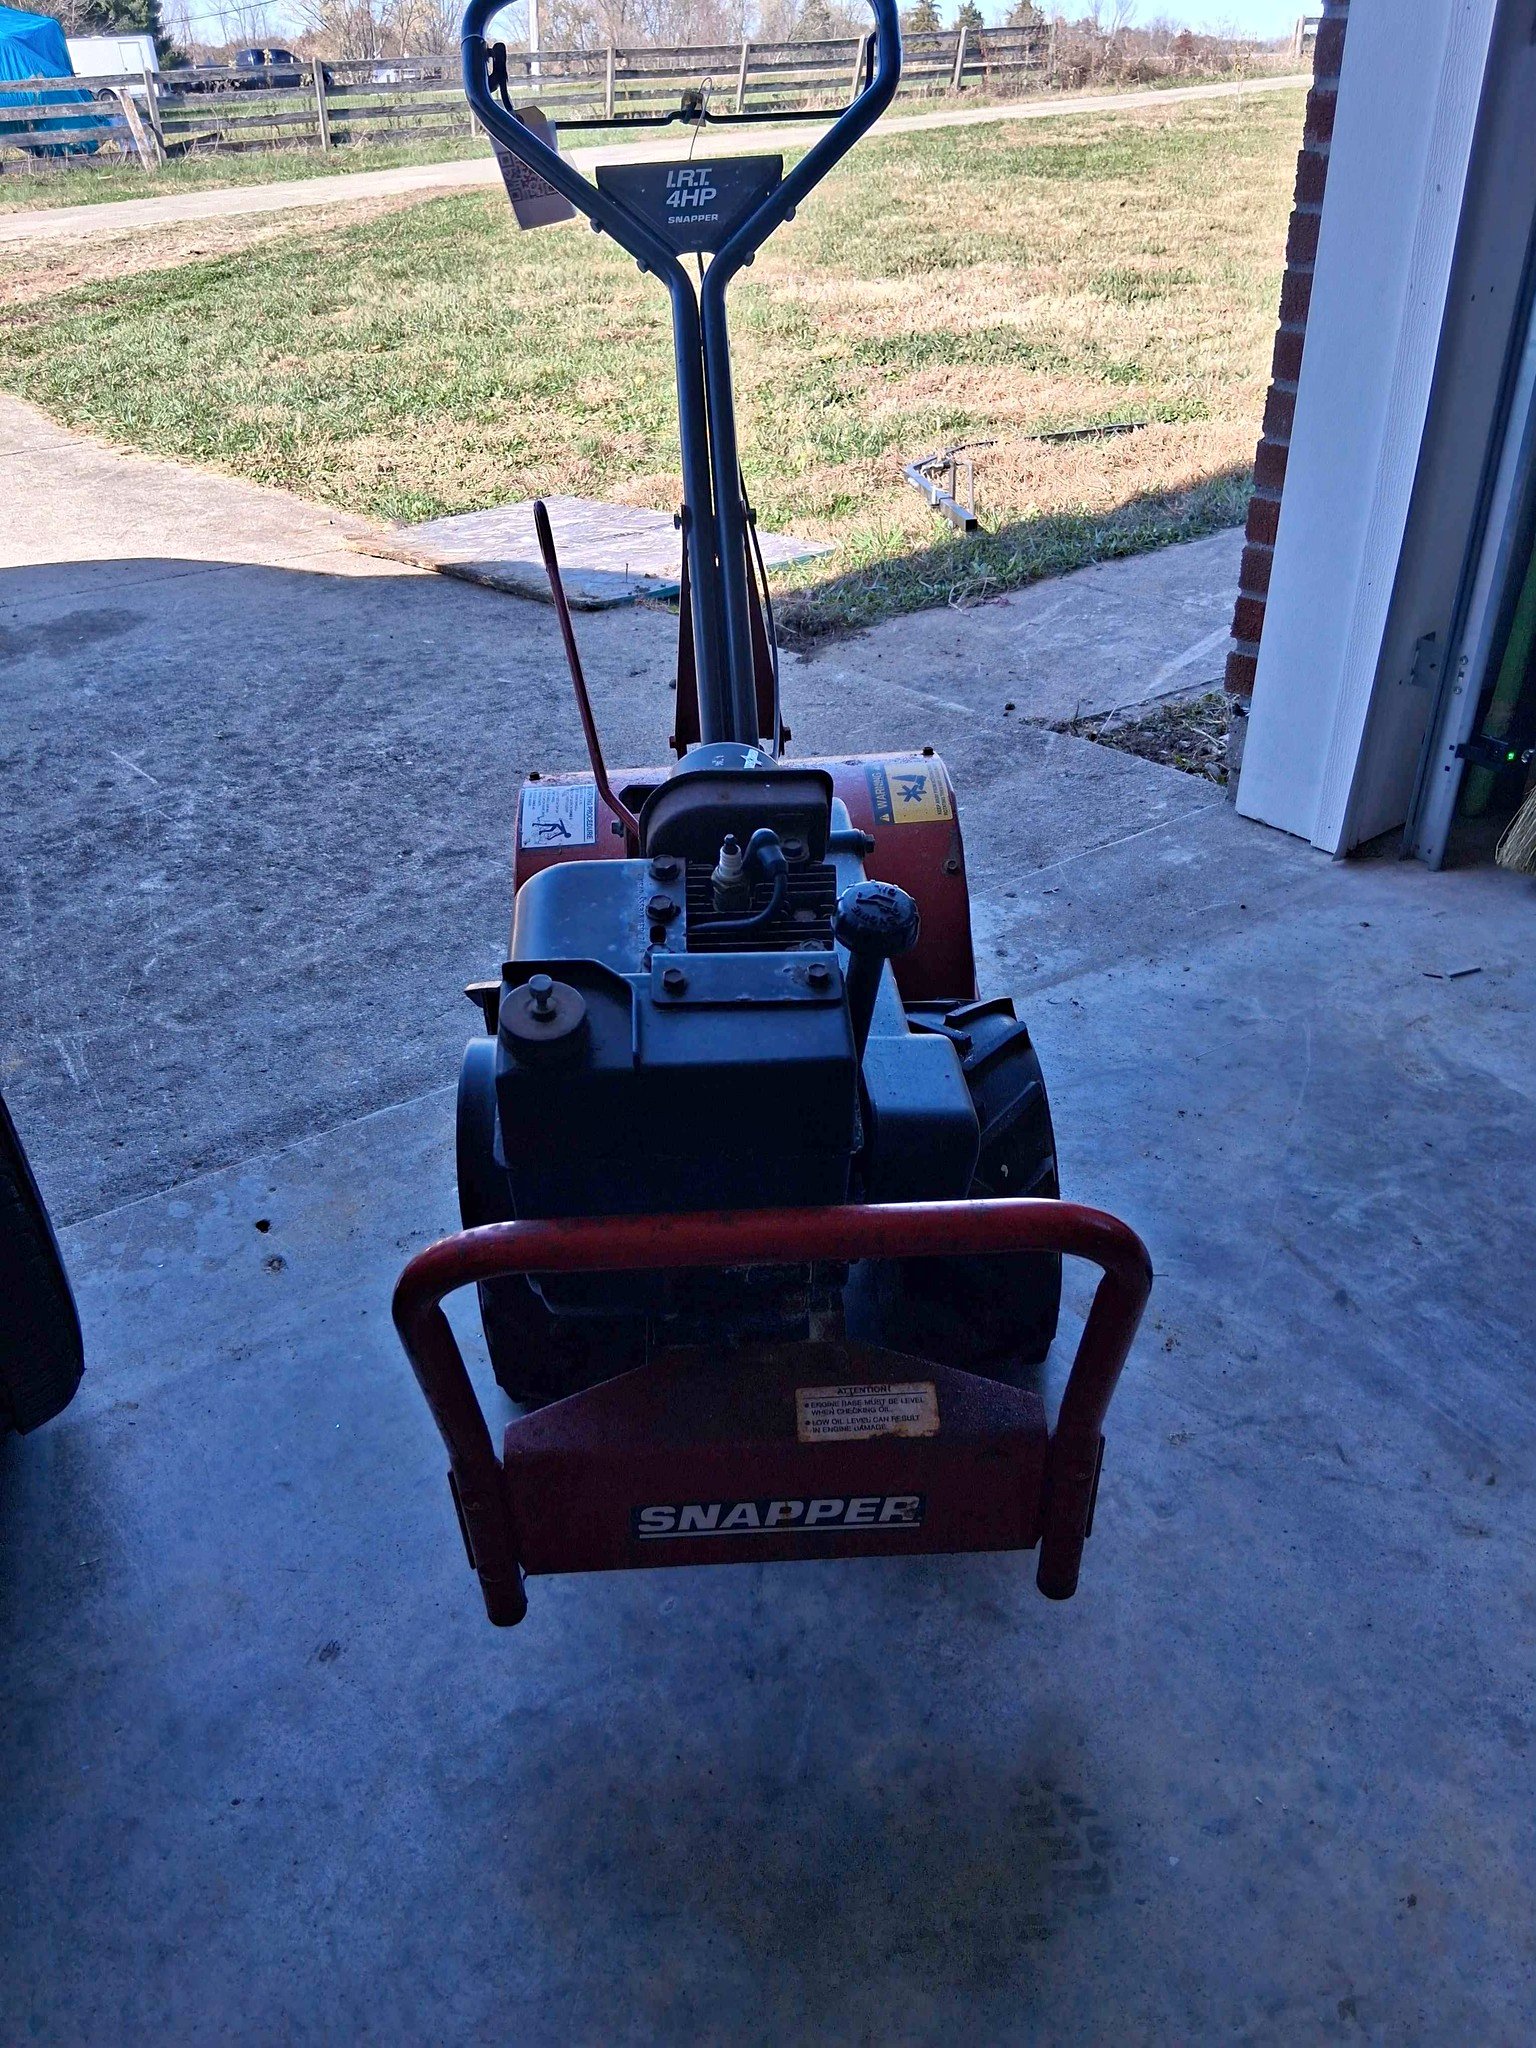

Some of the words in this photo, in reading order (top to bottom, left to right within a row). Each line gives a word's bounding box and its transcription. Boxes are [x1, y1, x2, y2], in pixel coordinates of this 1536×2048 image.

[666, 168, 712, 188] I.R.T.
[666, 188, 717, 207] 4HP
[668, 214, 719, 224] SNAPPER
[872, 772, 888, 809] WARNING
[586, 805, 594, 840] PROCEDURE
[837, 1386, 891, 1395] ATTENTION!
[864, 1398, 885, 1406] MUST
[811, 1408, 834, 1416] WHEN
[837, 1407, 876, 1415] CHECKING
[832, 1418, 844, 1426] OIL
[846, 1417, 871, 1425] LEVEL
[891, 1414, 920, 1422] RESULT
[823, 1425, 852, 1433] ENGINE
[639, 1496, 919, 1532] SNAPPER
